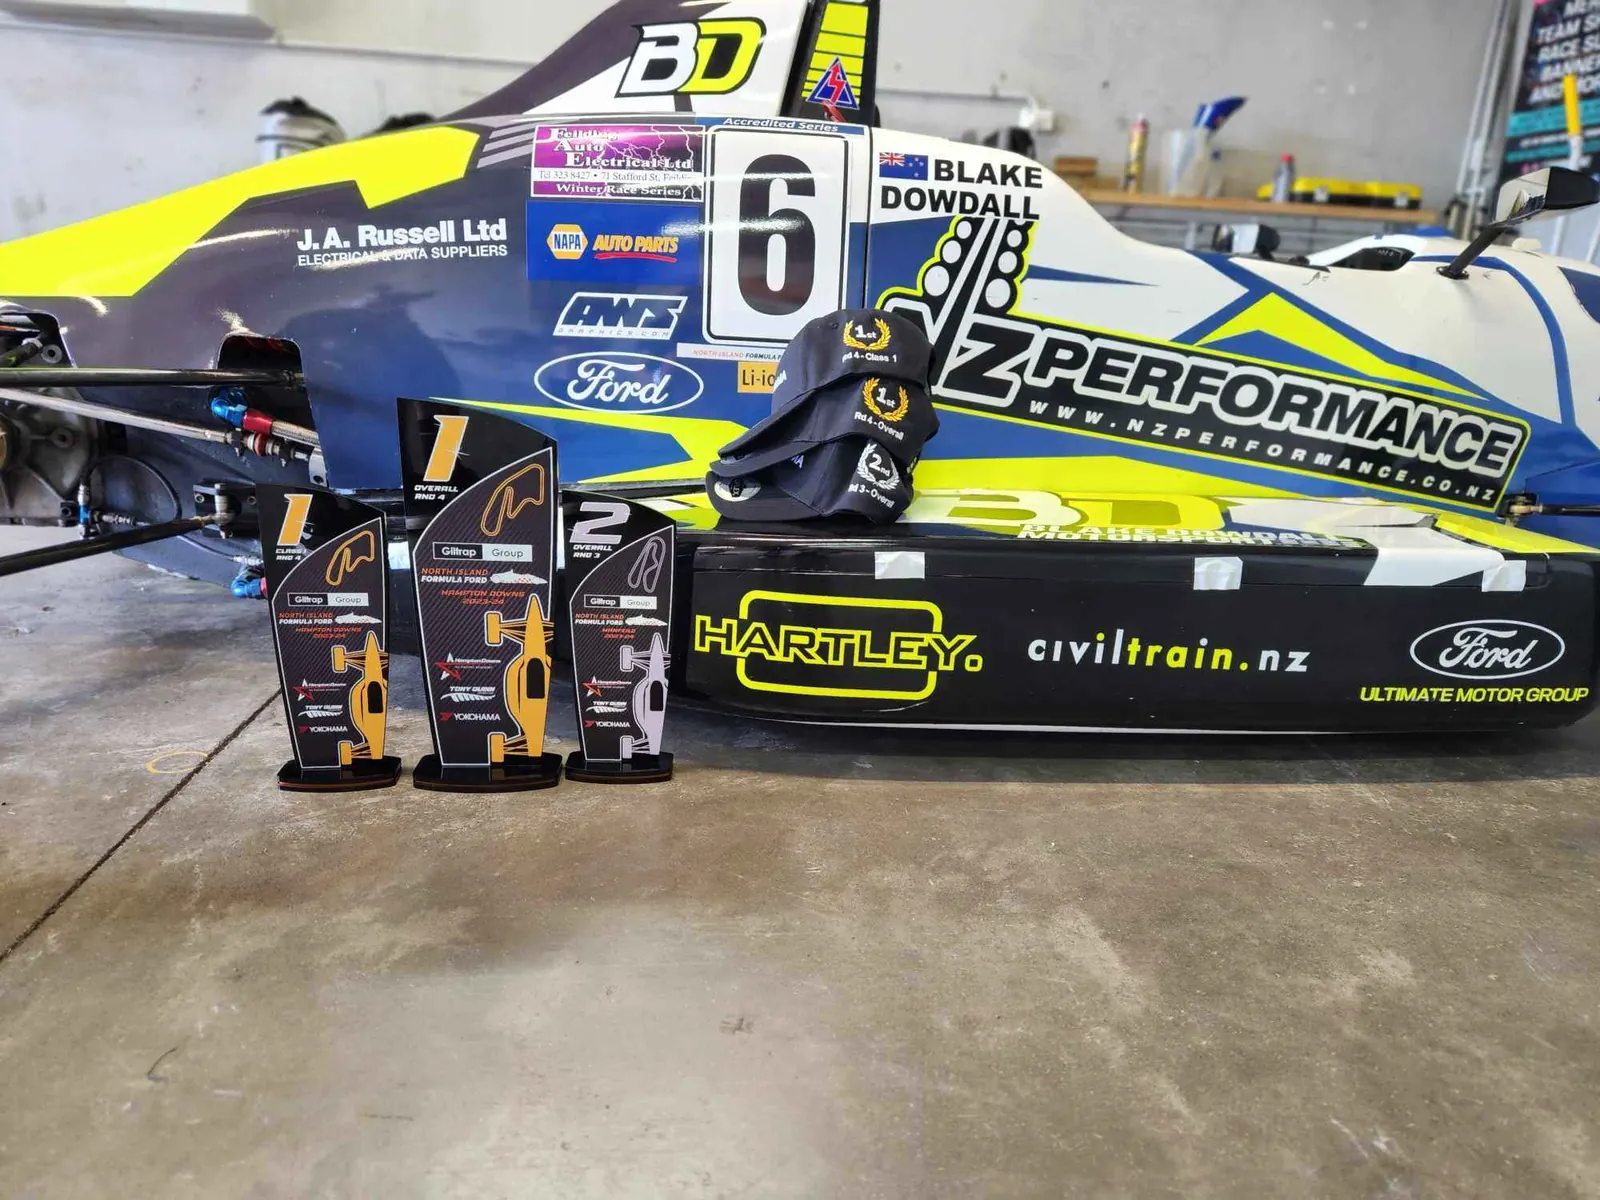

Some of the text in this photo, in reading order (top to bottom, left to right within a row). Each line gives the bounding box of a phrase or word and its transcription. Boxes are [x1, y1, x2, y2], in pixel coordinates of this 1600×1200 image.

[615, 17, 766, 98] BD
[723, 117, 839, 132] Accredited Series
[554, 139, 605, 151] Auto
[565, 152, 692, 169] Electrical Ltd
[539, 170, 553, 179] Tel
[553, 171, 570, 180] 323
[571, 171, 591, 180] 8427
[612, 171, 648, 182] Stafford
[934, 159, 1043, 188] BLAKE
[556, 183, 682, 196] Winter Race Series
[881, 185, 1041, 220] DOWDALL
[357, 220, 455, 247] Russell
[463, 218, 507, 242] Ltd
[738, 154, 816, 316] 6
[554, 233, 582, 251] NAPA
[592, 234, 679, 254] AUTO PARTS
[298, 251, 377, 267] ELECTRICAL
[394, 247, 428, 261] DATA
[431, 244, 508, 259] SUPPLIERS
[855, 325, 877, 339] 1st
[693, 349, 717, 357] NORTH
[718, 350, 744, 358] ISLAND
[745, 352, 776, 361] FORMULA
[567, 359, 671, 404] Ford
[742, 369, 776, 387] Li-io
[876, 387, 896, 408] 1st
[423, 415, 469, 482] 1
[869, 453, 891, 477] 2nd
[414, 484, 459, 493] OVERALL
[414, 493, 436, 501] RND
[276, 494, 314, 546] 1
[569, 501, 631, 545] 2
[441, 546, 524, 559] Giltrap Group
[573, 544, 613, 552] OVERALL
[421, 575, 488, 584] FORMULA FORD
[294, 595, 362, 605] Giltrap Group
[441, 589, 487, 597] HAMPTON
[590, 597, 651, 607] Giltrap Group
[1438, 626, 1533, 670] Ford
[1360, 687, 1588, 703] ULTIMATE MOTOR GROUP
[454, 713, 501, 721] YOKOHAMA
[309, 725, 348, 733] YOKOHAMA
